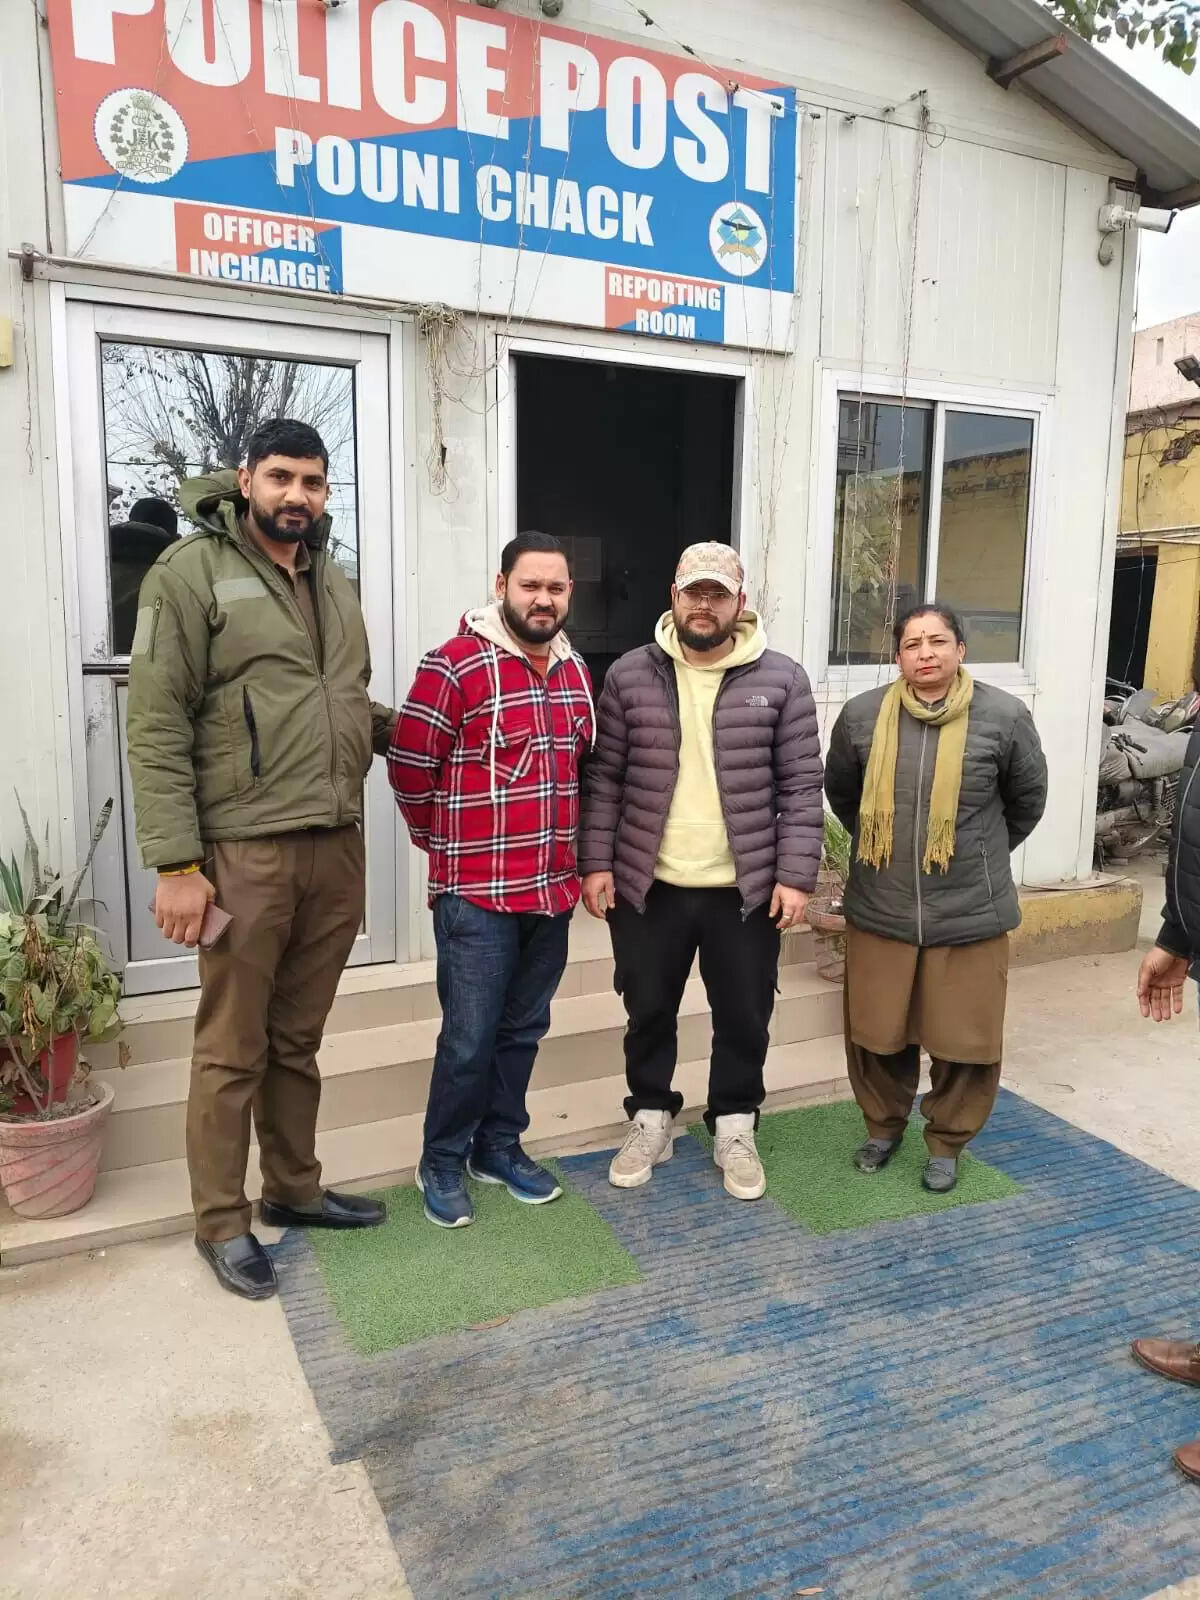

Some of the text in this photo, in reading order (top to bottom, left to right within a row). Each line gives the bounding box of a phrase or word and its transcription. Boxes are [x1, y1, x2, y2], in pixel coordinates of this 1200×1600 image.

[540, 36, 785, 194] POST
[274, 126, 655, 246] POUNI CHACK
[203, 212, 316, 253] OFFICER
[189, 248, 331, 290] INCHARGE
[608, 272, 721, 311] REPORTING
[635, 308, 696, 339] ROOM
